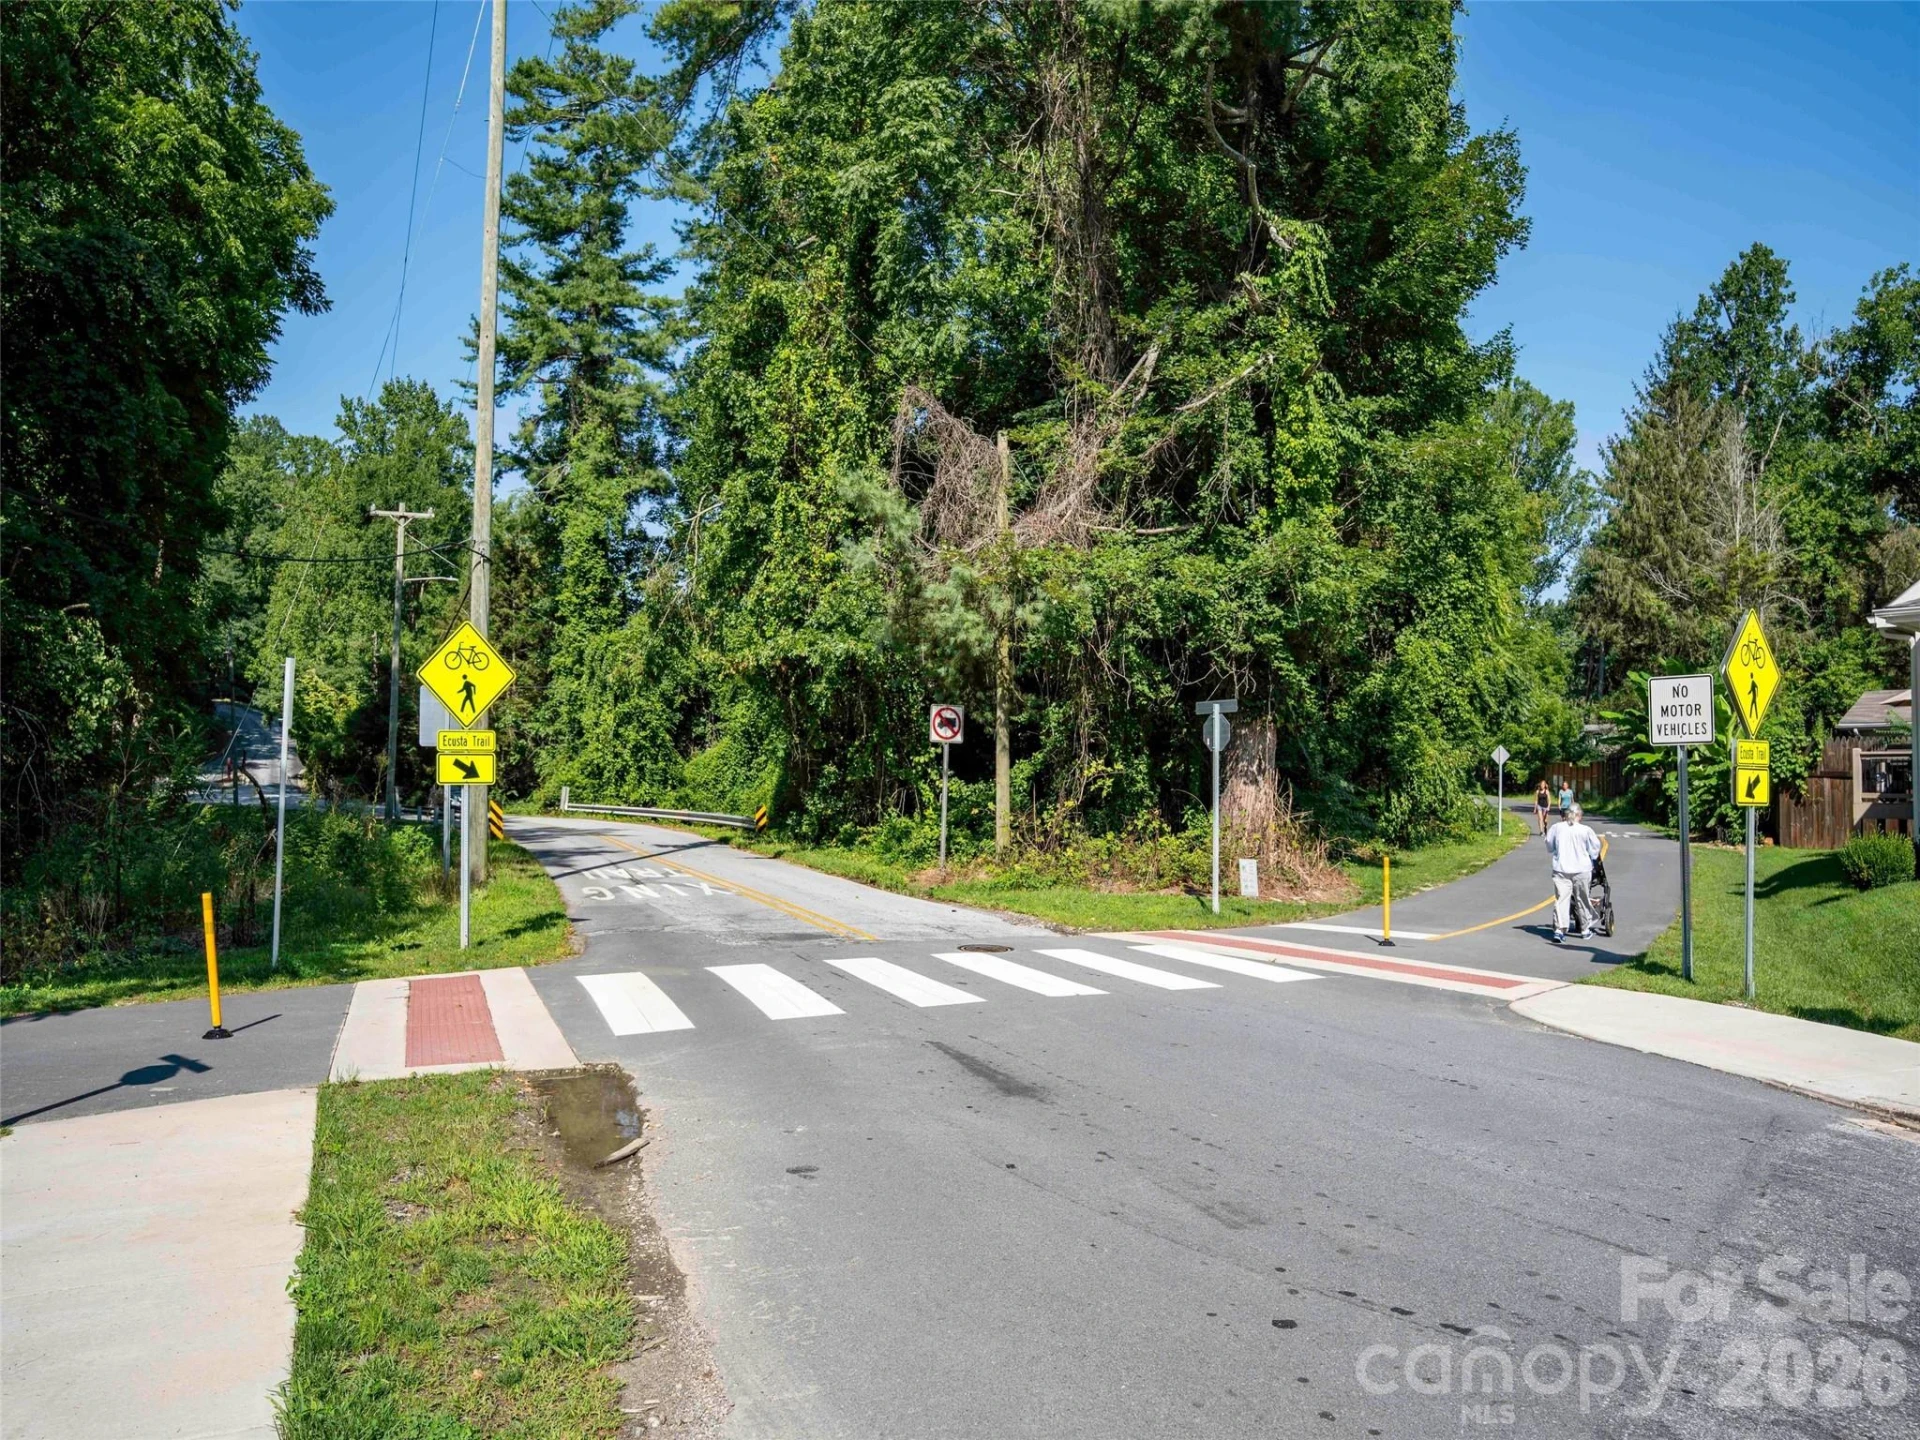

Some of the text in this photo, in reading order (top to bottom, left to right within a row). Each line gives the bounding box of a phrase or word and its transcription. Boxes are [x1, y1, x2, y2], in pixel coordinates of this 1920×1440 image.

[1672, 685, 1688, 698] NO
[1661, 704, 1702, 718] MOTOR
[1657, 722, 1707, 736] VEHICLES
[442, 735, 490, 747] Ecusta Trail
